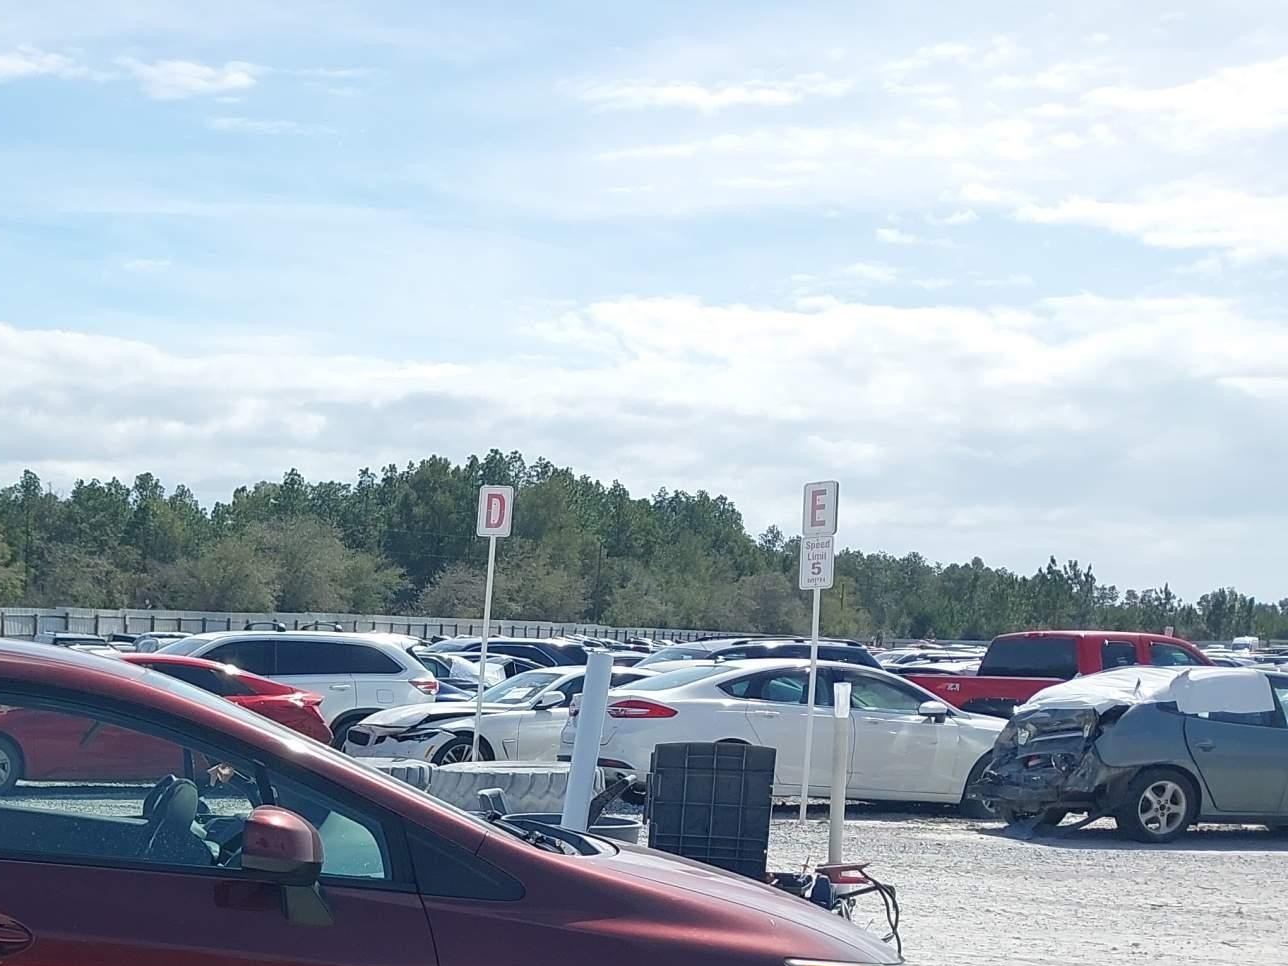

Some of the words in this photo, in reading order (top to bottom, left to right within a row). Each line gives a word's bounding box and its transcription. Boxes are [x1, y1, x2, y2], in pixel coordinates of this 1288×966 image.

[484, 493, 506, 529] D
[810, 488, 827, 528] E
[805, 540, 831, 551] Speed
[807, 552, 827, 561] Limit
[811, 562, 822, 575] 5
